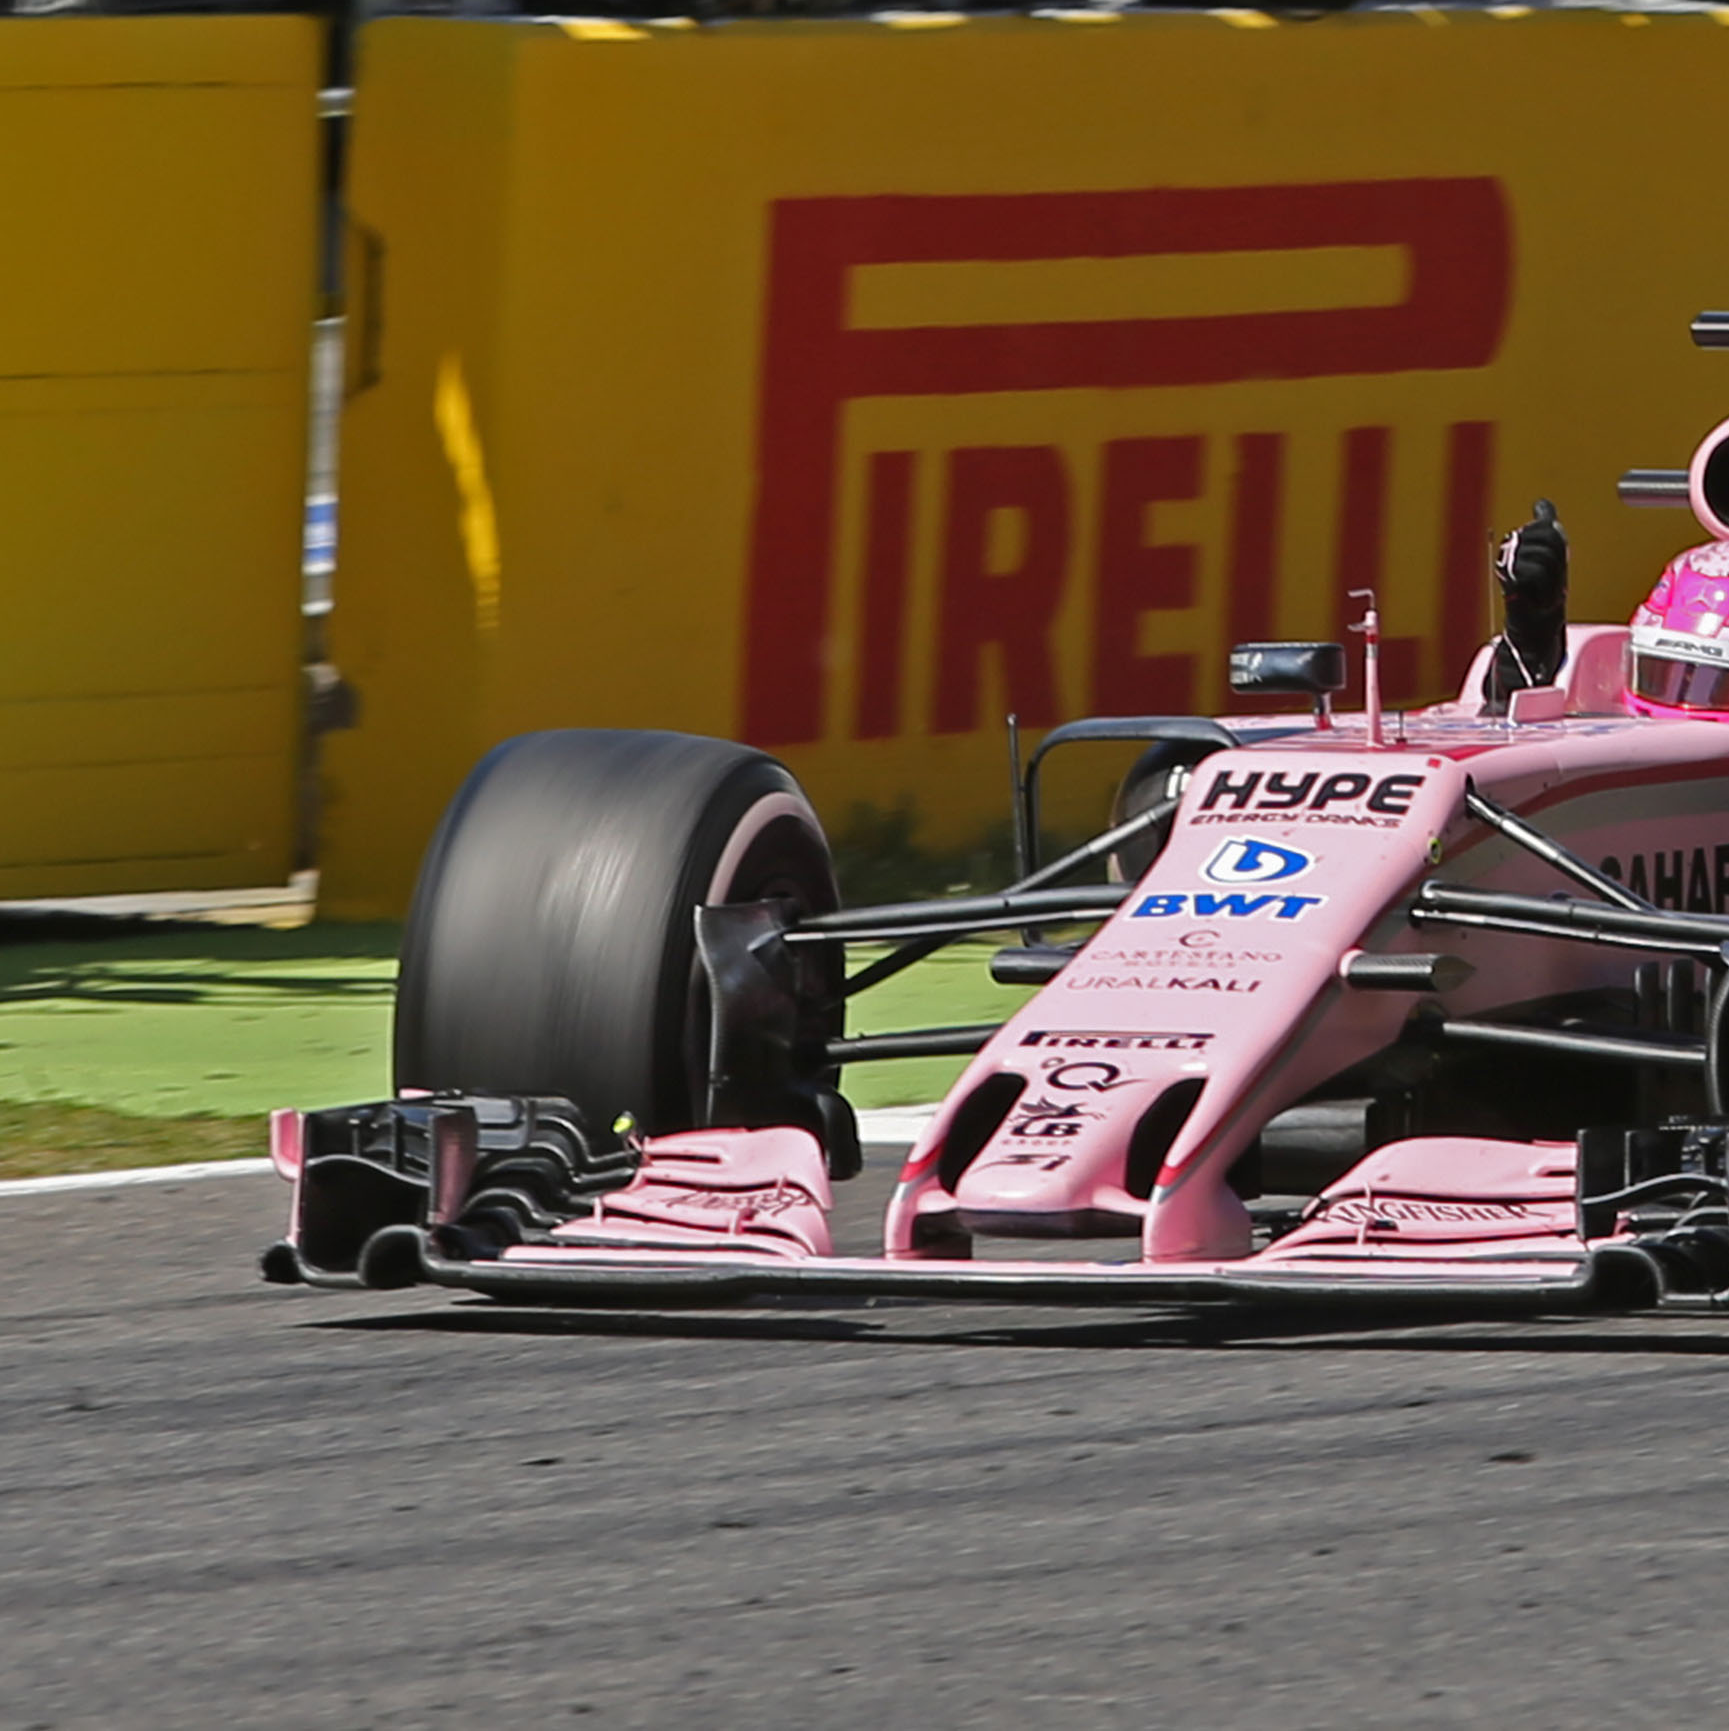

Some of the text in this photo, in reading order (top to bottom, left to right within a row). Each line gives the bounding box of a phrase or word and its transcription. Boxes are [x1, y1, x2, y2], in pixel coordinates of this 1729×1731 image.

[738, 175, 1516, 747] PIRELLI
[1198, 770, 1426, 816] HYPE
[1189, 813, 1401, 829] ENERGY DRINKS
[1130, 893, 1324, 920] BWT
[1066, 975, 1262, 993] URALKALI
[1018, 1030, 1216, 1050] PIRELLI
